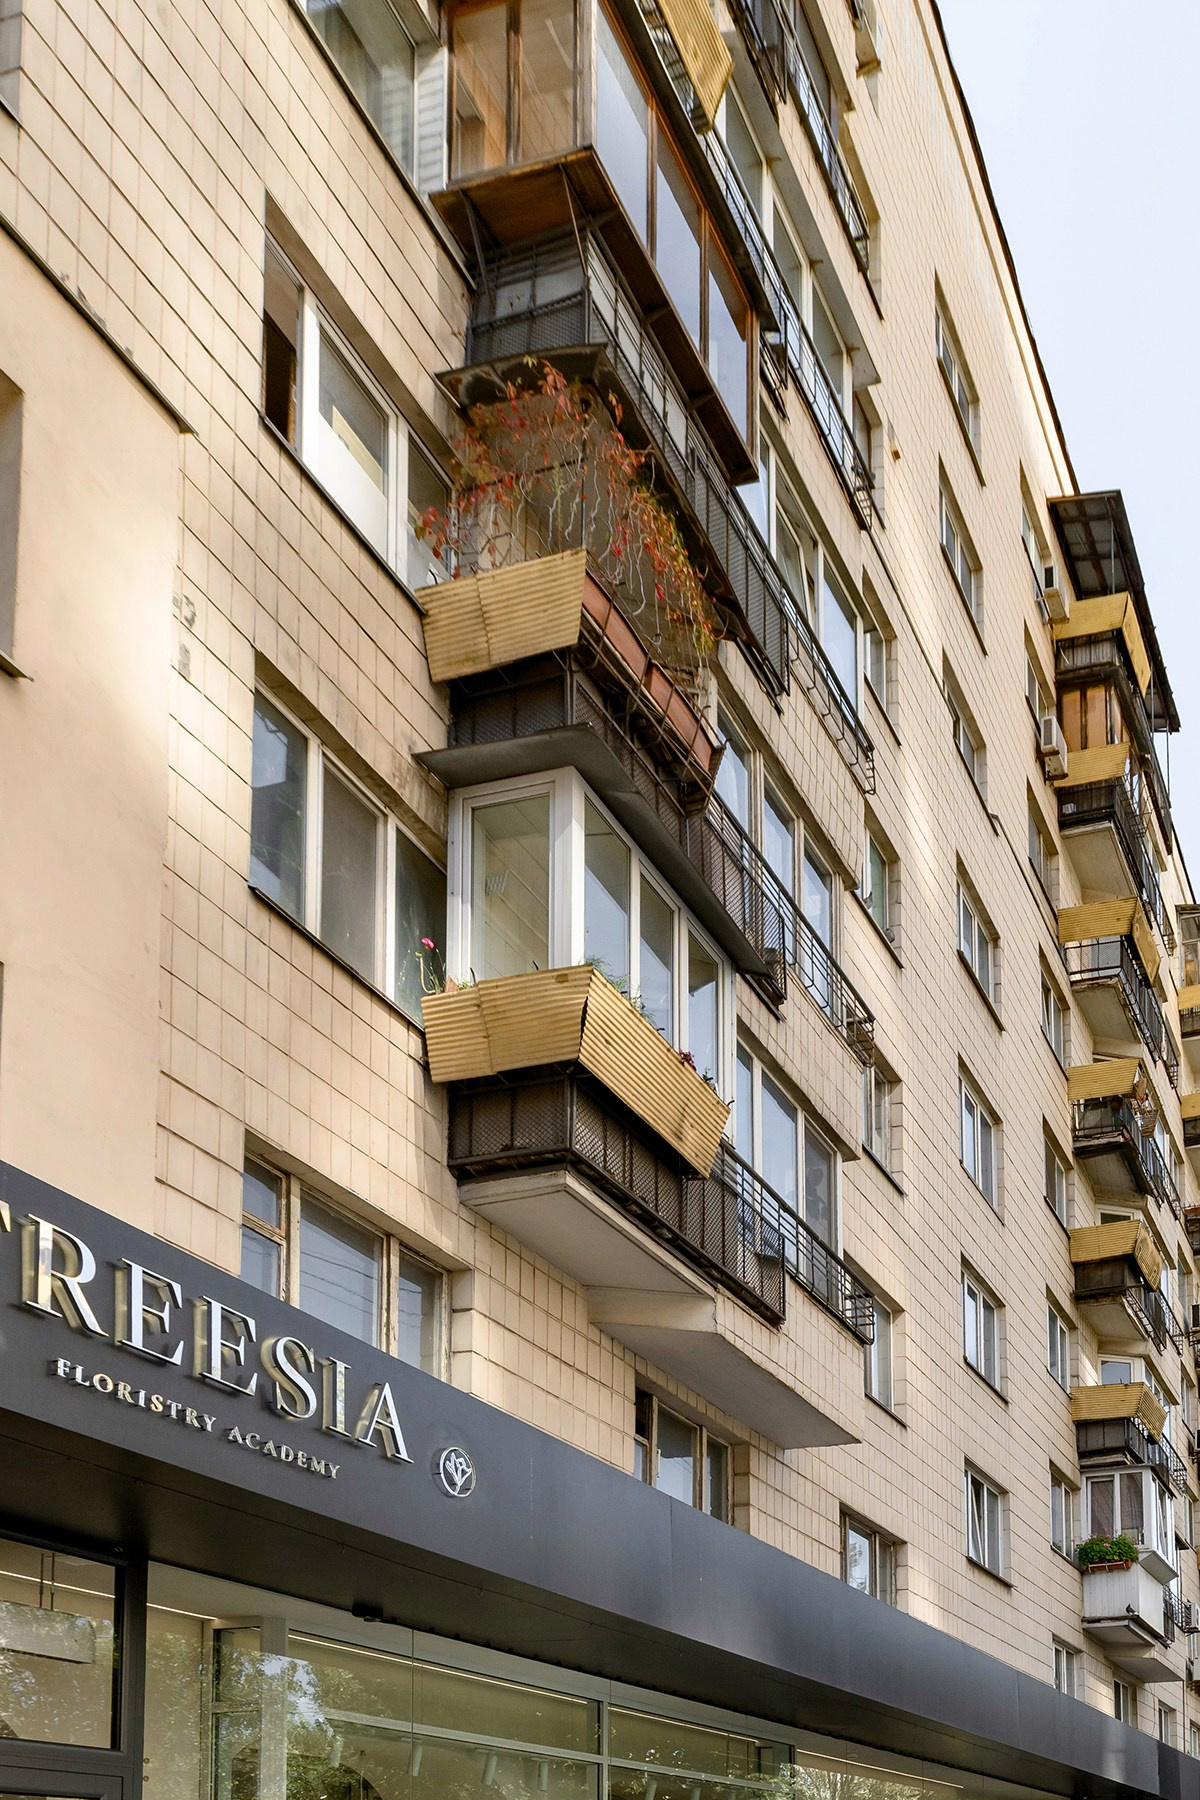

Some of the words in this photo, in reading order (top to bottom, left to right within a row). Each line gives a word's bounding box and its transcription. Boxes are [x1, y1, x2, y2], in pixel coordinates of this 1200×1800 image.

[0, 1200, 414, 1464] REESIA
[56, 1357, 217, 1433] FLORISTRY
[227, 1426, 341, 1479] ACADEMY
